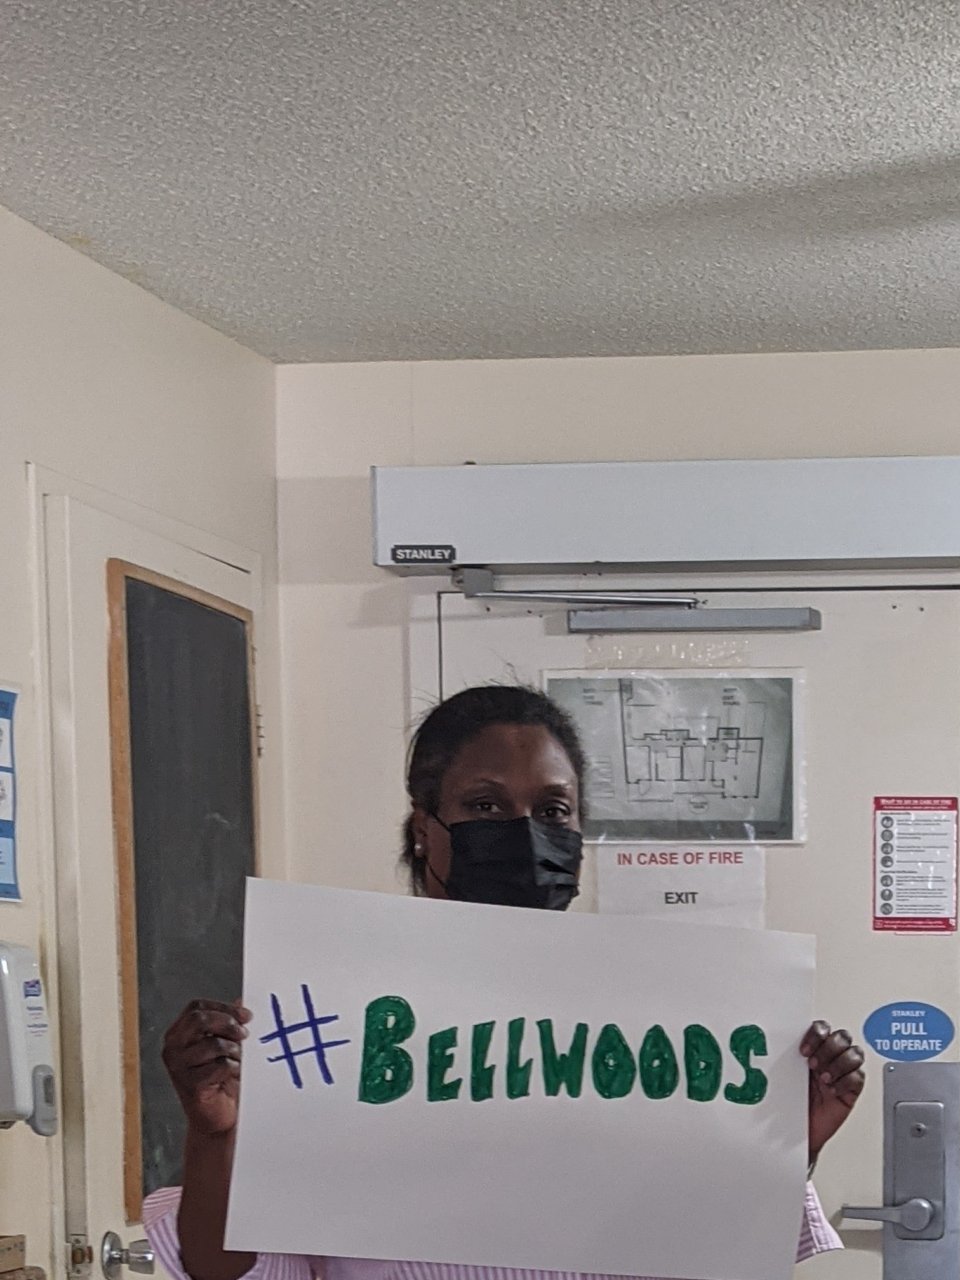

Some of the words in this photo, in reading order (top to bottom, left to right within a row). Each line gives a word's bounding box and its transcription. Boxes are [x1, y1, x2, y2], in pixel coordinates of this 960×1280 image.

[395, 549, 451, 559] STANLEY
[618, 852, 632, 865] IN
[637, 852, 679, 865] CASE
[683, 852, 704, 864] OF
[709, 851, 743, 864] FIRE
[664, 892, 698, 904] EXIT
[891, 1022, 928, 1035] PULL
[875, 1039, 890, 1051] TO
[892, 1039, 943, 1051] OPERATE
